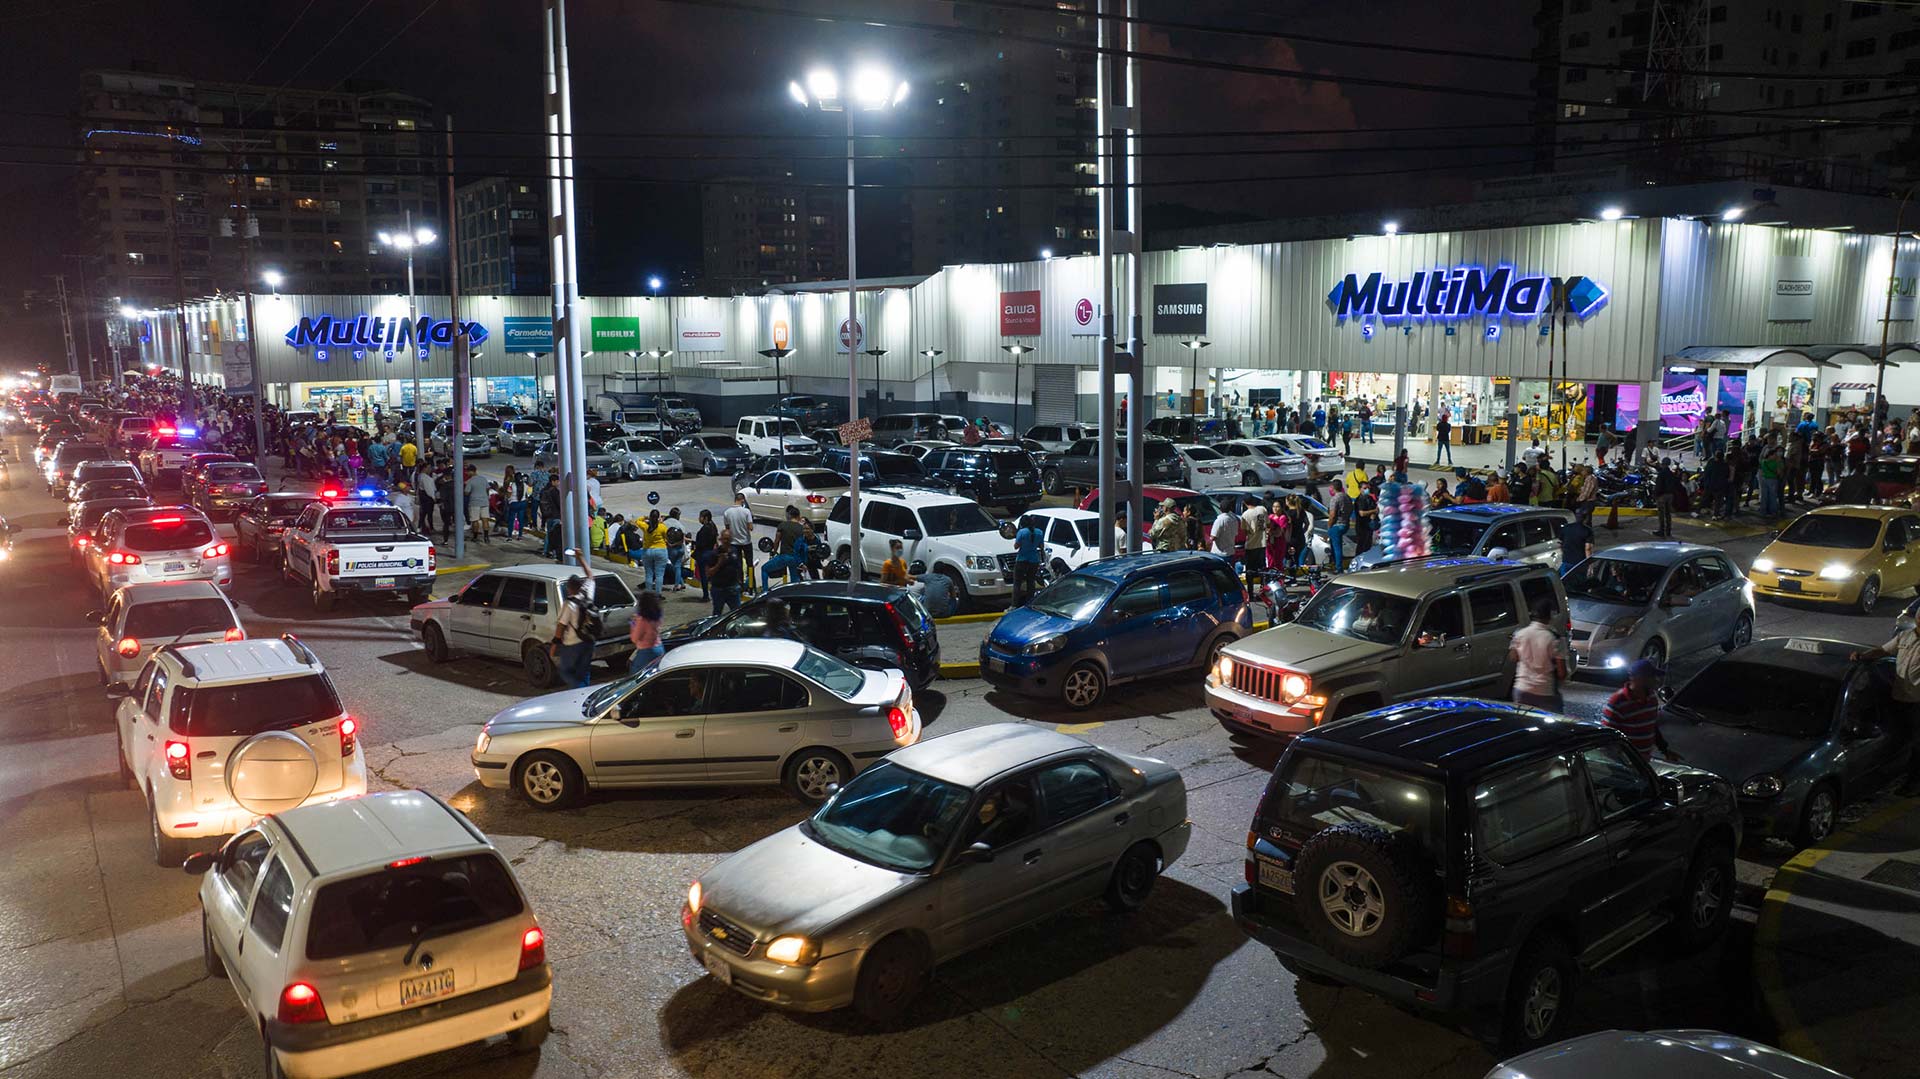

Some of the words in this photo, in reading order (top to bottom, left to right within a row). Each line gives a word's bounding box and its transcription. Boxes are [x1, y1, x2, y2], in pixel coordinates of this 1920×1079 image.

[1337, 268, 1583, 315] MultiMax
[1004, 303, 1036, 315] aiwa
[1157, 303, 1203, 315] SAMSUNG
[296, 315, 476, 345] MultiMax
[596, 330, 635, 338] FRIGILUX
[377, 560, 403, 568] MUNICIPAL
